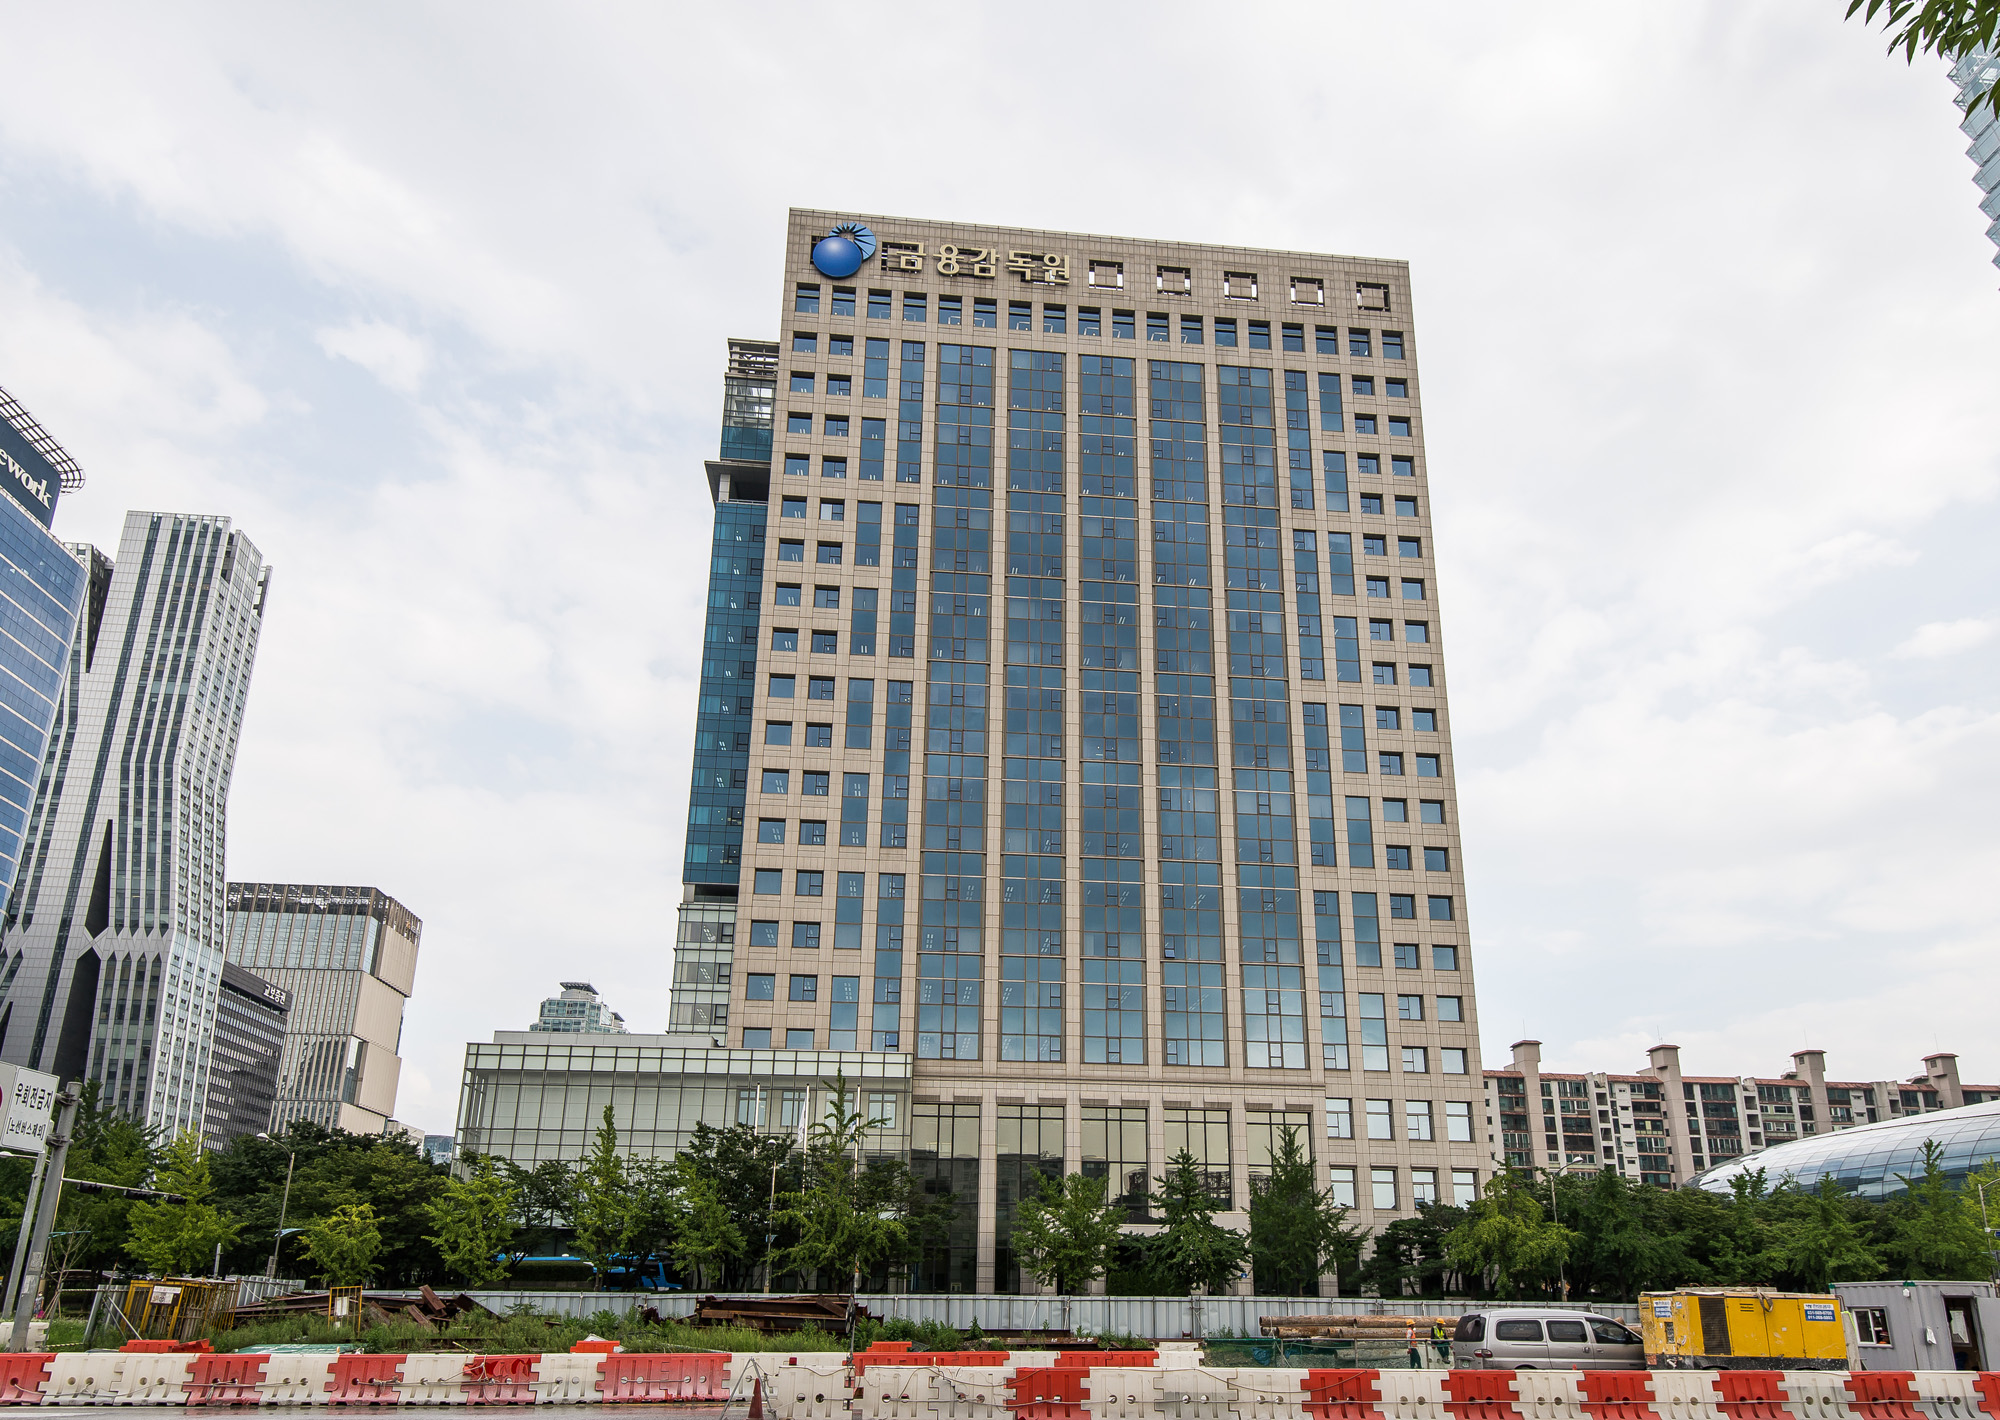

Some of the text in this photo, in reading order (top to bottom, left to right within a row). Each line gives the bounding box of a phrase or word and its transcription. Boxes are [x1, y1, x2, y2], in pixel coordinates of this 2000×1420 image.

[896, 240, 1070, 285] 금융감독원
[0, 448, 52, 510] ework
[15, 1082, 54, 1112] 우회전금지
